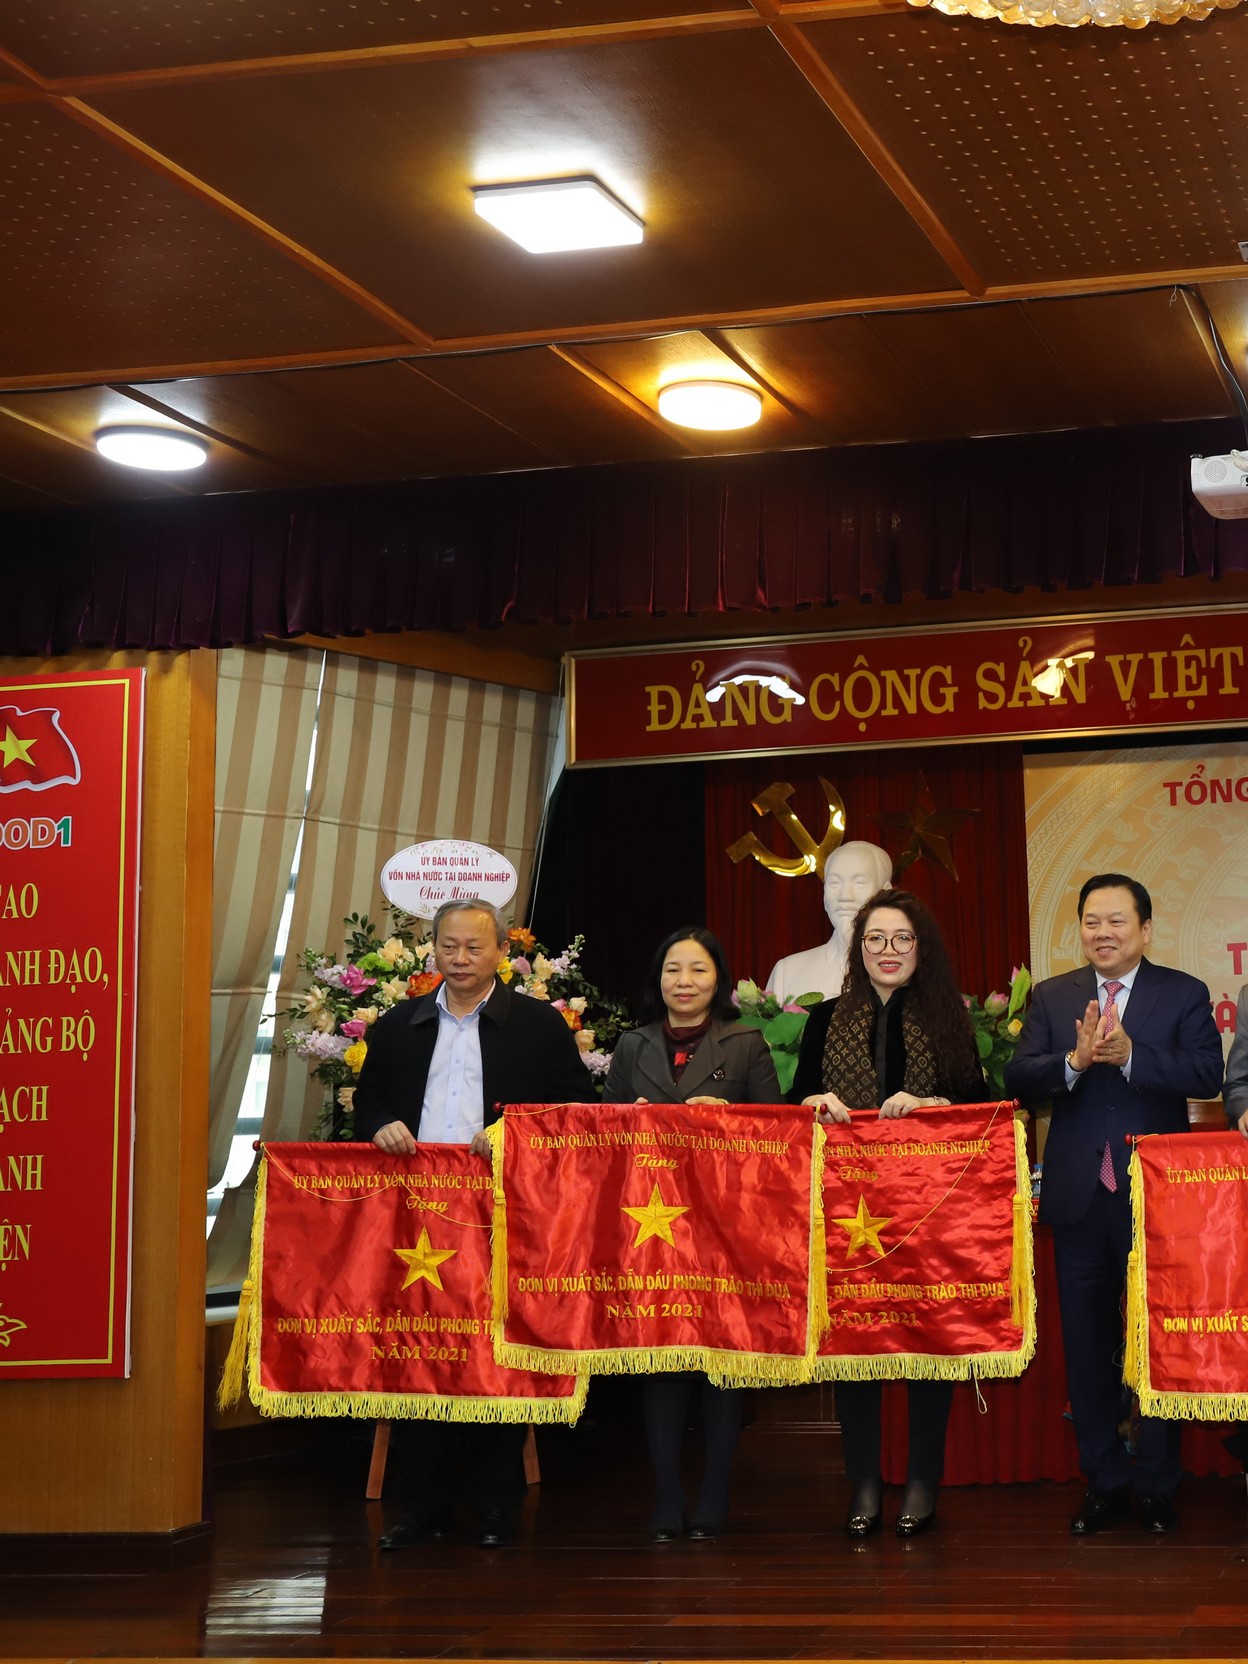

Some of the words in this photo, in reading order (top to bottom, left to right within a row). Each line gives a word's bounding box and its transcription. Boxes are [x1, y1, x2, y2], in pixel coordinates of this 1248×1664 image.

[645, 660, 796, 732] ĐẢNG
[808, 654, 959, 732] CỘNG
[975, 636, 1091, 711] SẢN
[1105, 633, 1244, 710] VIỆT
[0, 815, 72, 851] OD1
[432, 856, 448, 866] BAN
[423, 869, 443, 882] NƯỚC
[445, 871, 456, 884] TẠI
[457, 871, 482, 882] DOANH
[484, 870, 511, 884] NGHIỆP
[0, 882, 40, 919] AO
[0, 949, 42, 987] NH
[47, 947, 109, 994] ĐẠO,
[59, 1009, 96, 1062] BỘ
[547, 1135, 566, 1149] BAN
[568, 1131, 597, 1150] QUẢN
[599, 1129, 612, 1146] LÝ
[660, 1130, 689, 1148] NƯỚC
[690, 1135, 708, 1151] TẠI
[710, 1137, 747, 1153] DOANH
[748, 1139, 789, 1157] NGHIỆP
[634, 1153, 679, 1170] Tặng
[0, 1154, 45, 1191] NH
[312, 1174, 334, 1189] BAN
[335, 1171, 365, 1190] QUẢN
[367, 1171, 381, 1188] LÝ
[431, 1172, 463, 1190] NƯỚC
[465, 1175, 483, 1192] TẠI
[839, 1165, 879, 1182] Tặng
[1184, 1168, 1207, 1183] BAN
[1208, 1163, 1240, 1184] QUẢN
[405, 1195, 449, 1213] Tặng
[518, 1277, 544, 1293] ĐƠN
[546, 1277, 558, 1297] VỊ
[561, 1269, 592, 1292] XUẤT
[618, 1268, 643, 1291] DẪN
[646, 1268, 670, 1291] ĐẦU
[673, 1274, 712, 1292] PHONG
[713, 1275, 744, 1295] TRÀO
[745, 1280, 763, 1297] THI
[765, 1282, 791, 1299] ĐUA
[887, 1283, 923, 1300] PHONG
[925, 1281, 957, 1300] TRÀO
[958, 1283, 979, 1298] THI
[980, 1282, 1006, 1297] ĐUA
[606, 1301, 657, 1318] NĂM
[661, 1303, 703, 1318] 2021
[878, 1311, 918, 1327] 2021
[277, 1317, 301, 1333] ĐƠN
[304, 1318, 317, 1339] VỊ
[319, 1311, 354, 1334] XUẤT
[386, 1309, 410, 1332] DẪN
[413, 1311, 438, 1333] ĐẦU
[440, 1318, 480, 1335] PHONG
[1163, 1317, 1189, 1334] ĐƠN
[1191, 1317, 1204, 1339] VỊ
[1206, 1309, 1239, 1333] XUẤT
[371, 1342, 422, 1360] NĂM
[427, 1346, 468, 1362] 2021
